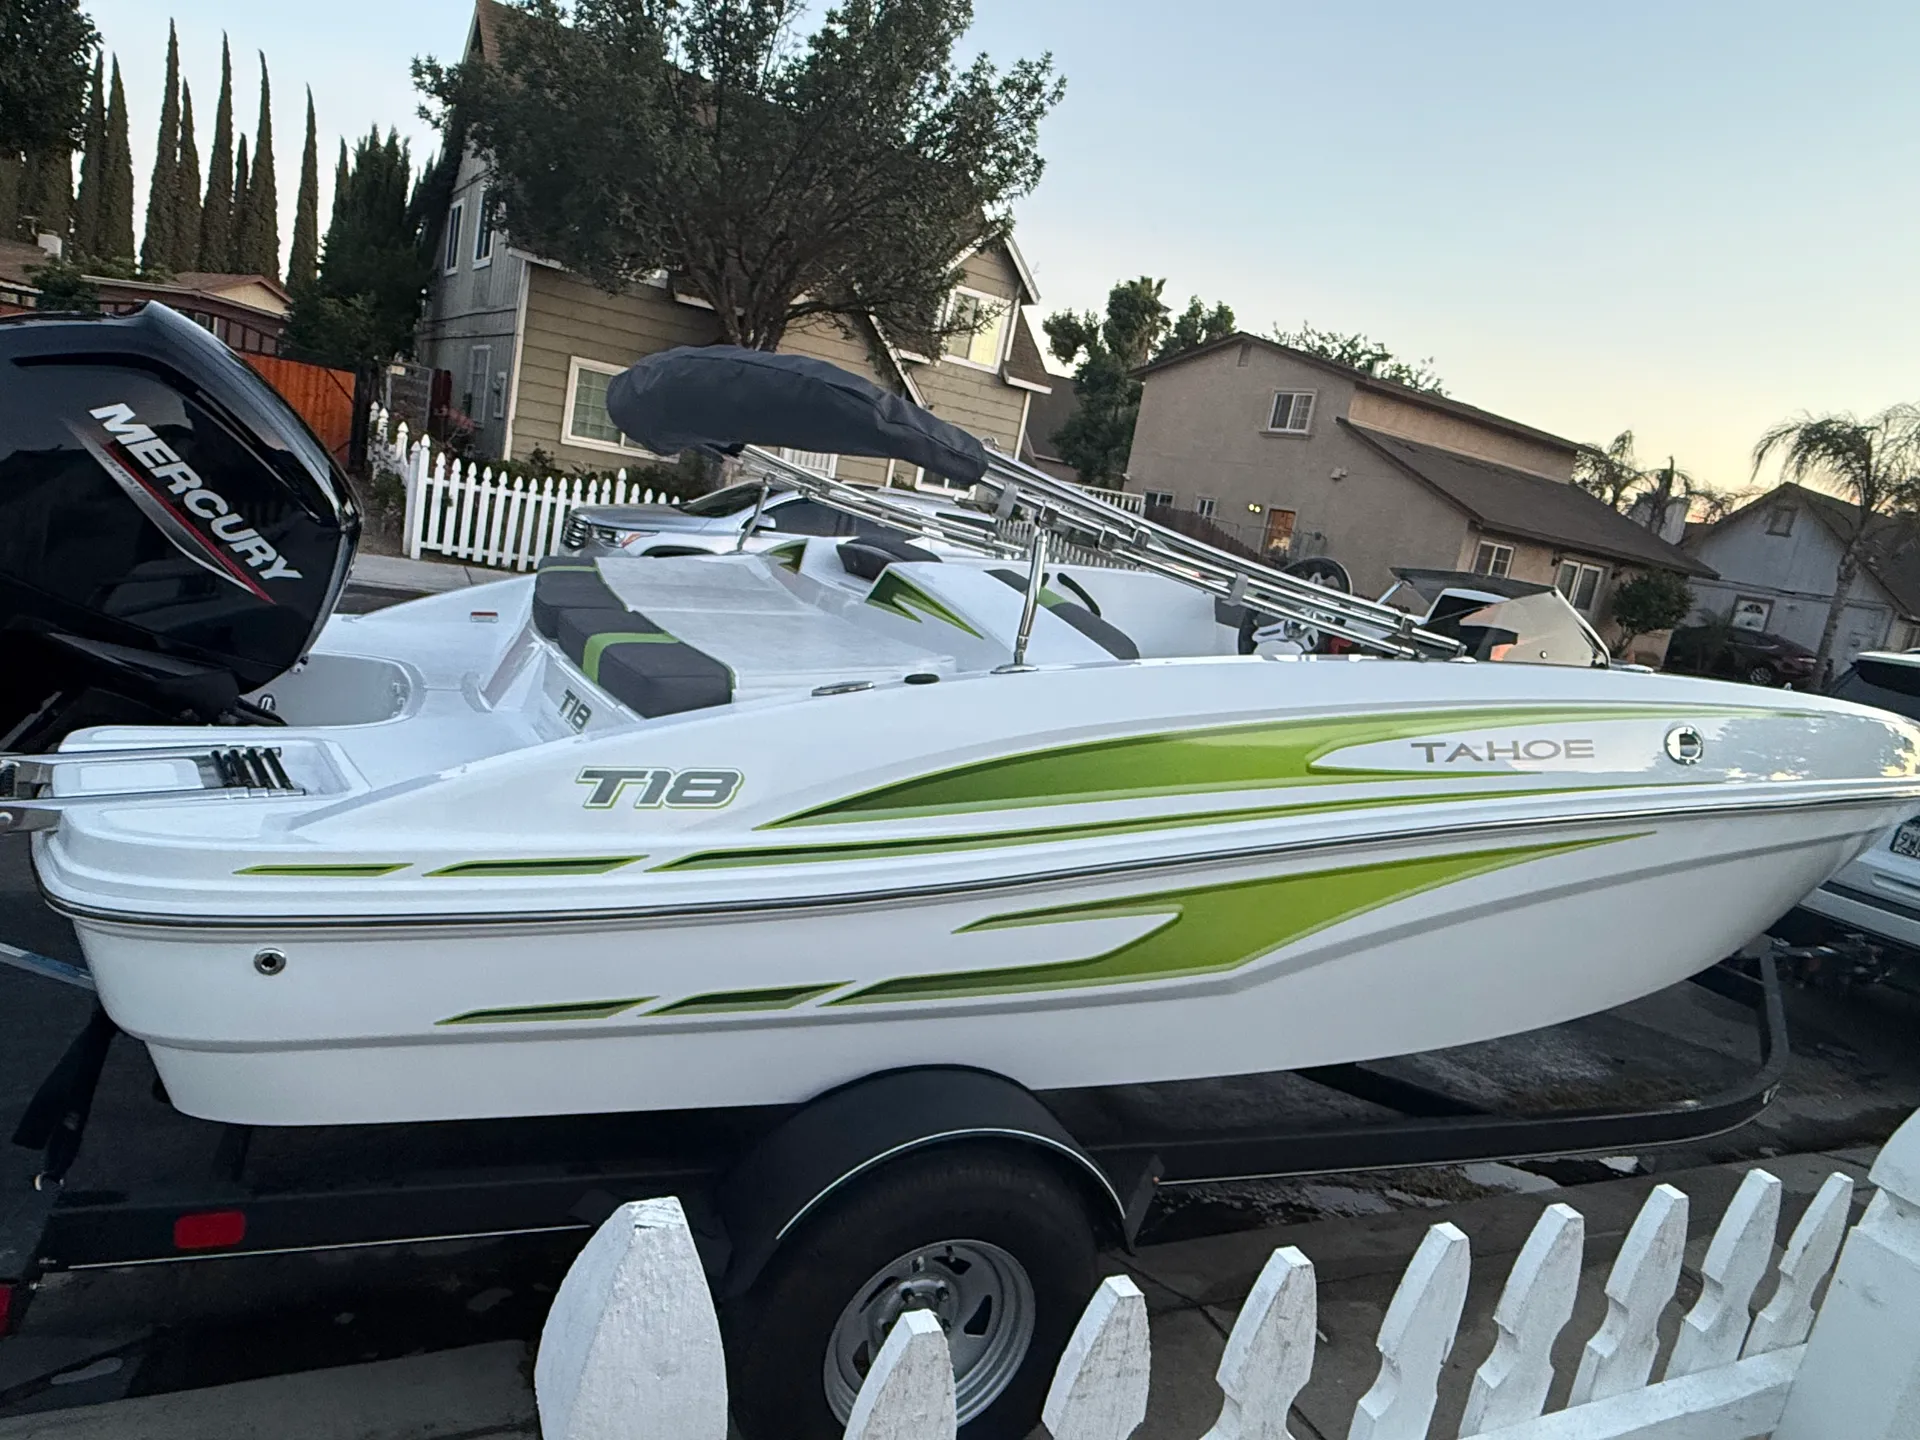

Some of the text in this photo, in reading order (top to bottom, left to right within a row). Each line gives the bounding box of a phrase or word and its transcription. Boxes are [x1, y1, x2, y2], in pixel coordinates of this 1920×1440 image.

[89, 403, 303, 580] MERCURY
[557, 687, 592, 735] T18
[1411, 739, 1595, 763] TAHOE
[575, 766, 745, 809] T18
